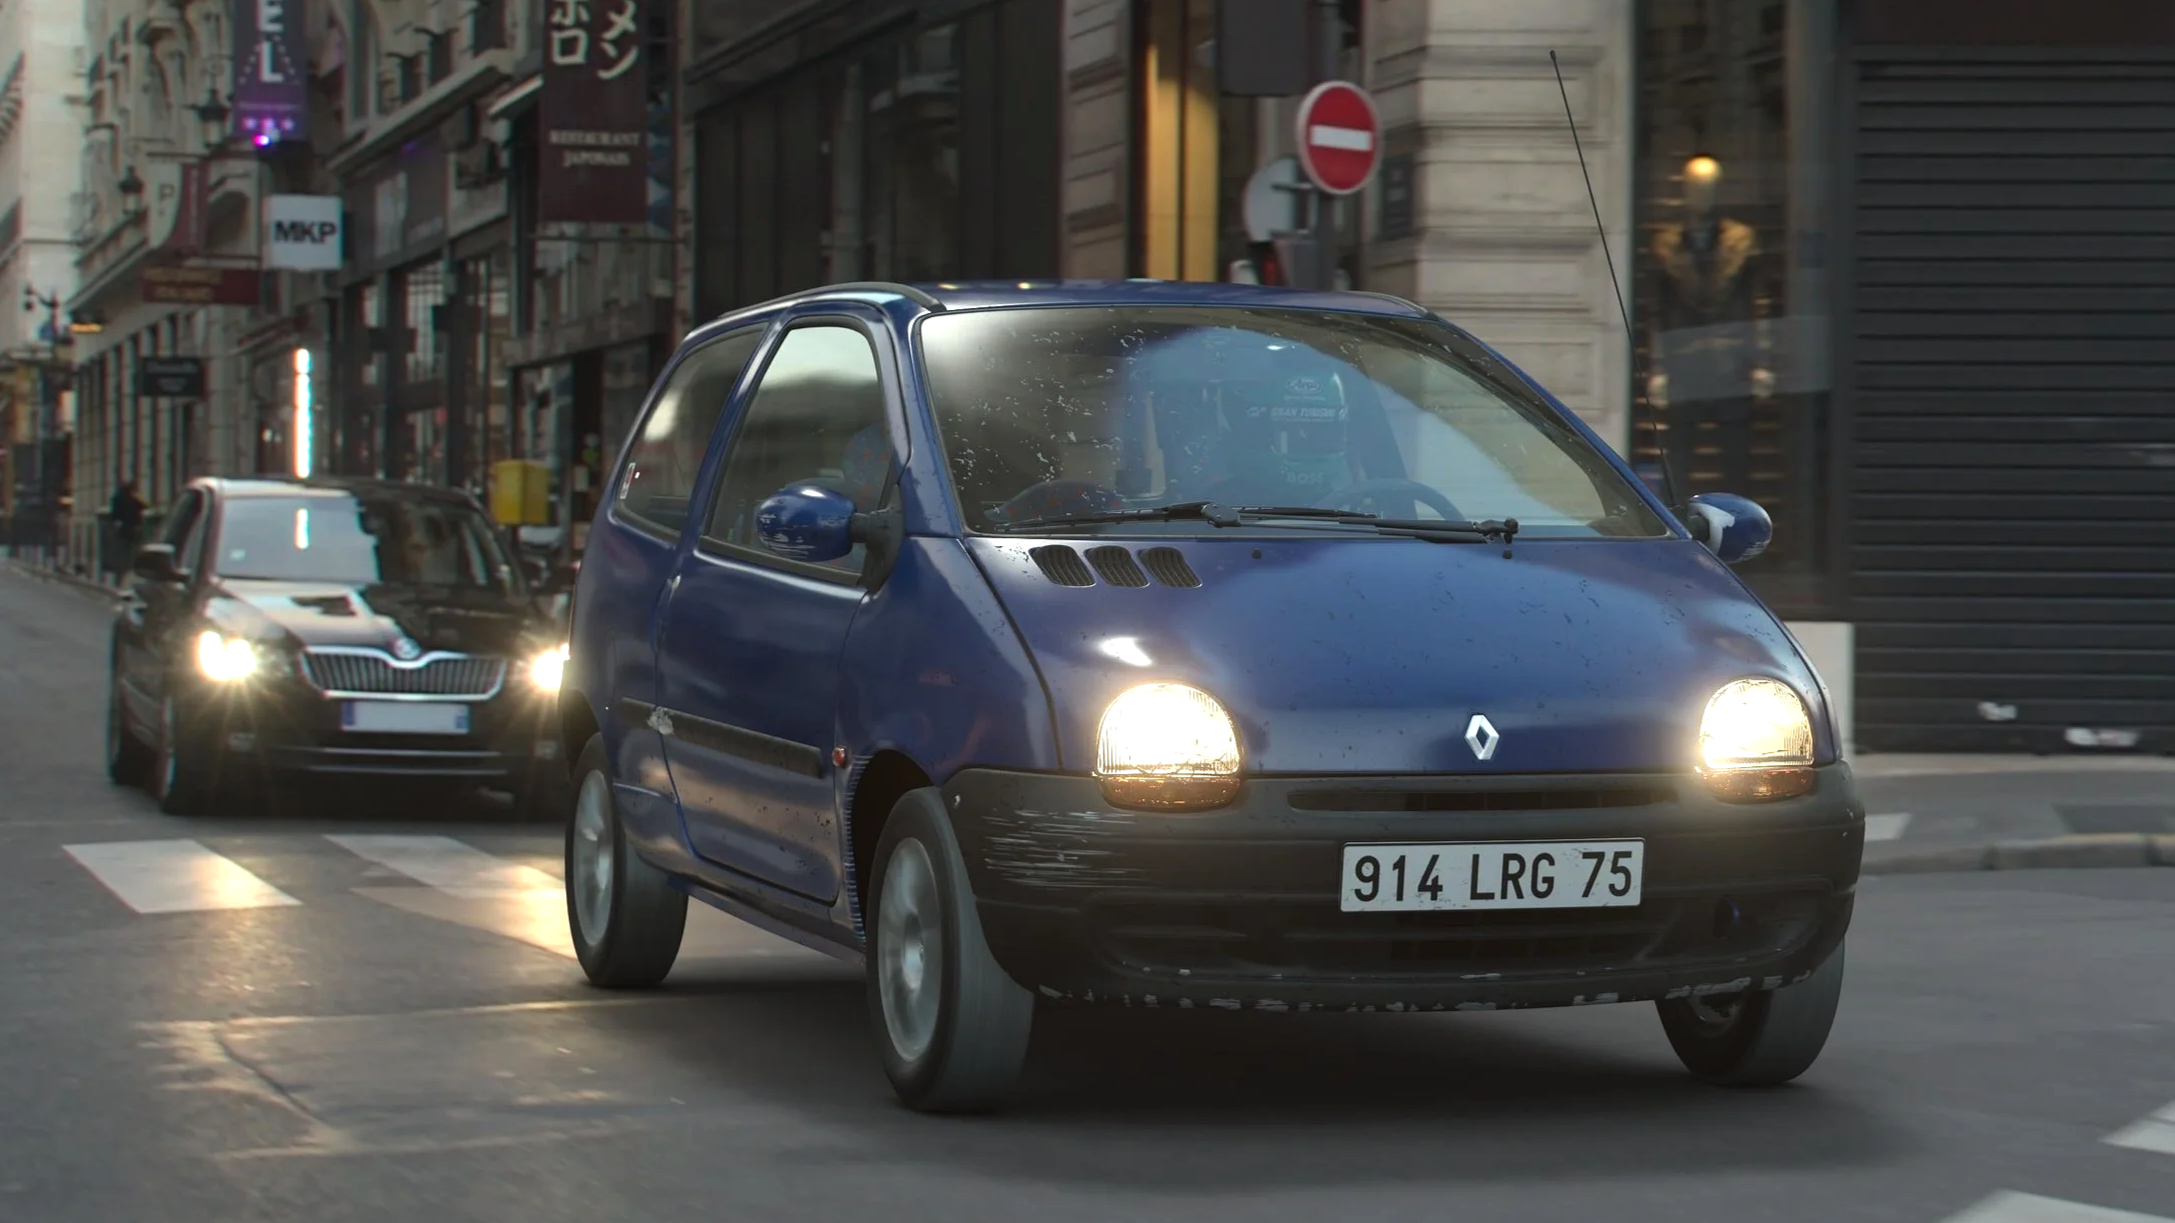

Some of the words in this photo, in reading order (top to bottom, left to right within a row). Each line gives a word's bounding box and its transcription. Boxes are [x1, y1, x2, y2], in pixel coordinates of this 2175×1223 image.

[274, 220, 336, 245] MKP
[1354, 854, 1444, 902] 914
[1470, 852, 1556, 900] LRG
[1581, 850, 1632, 898] 75
